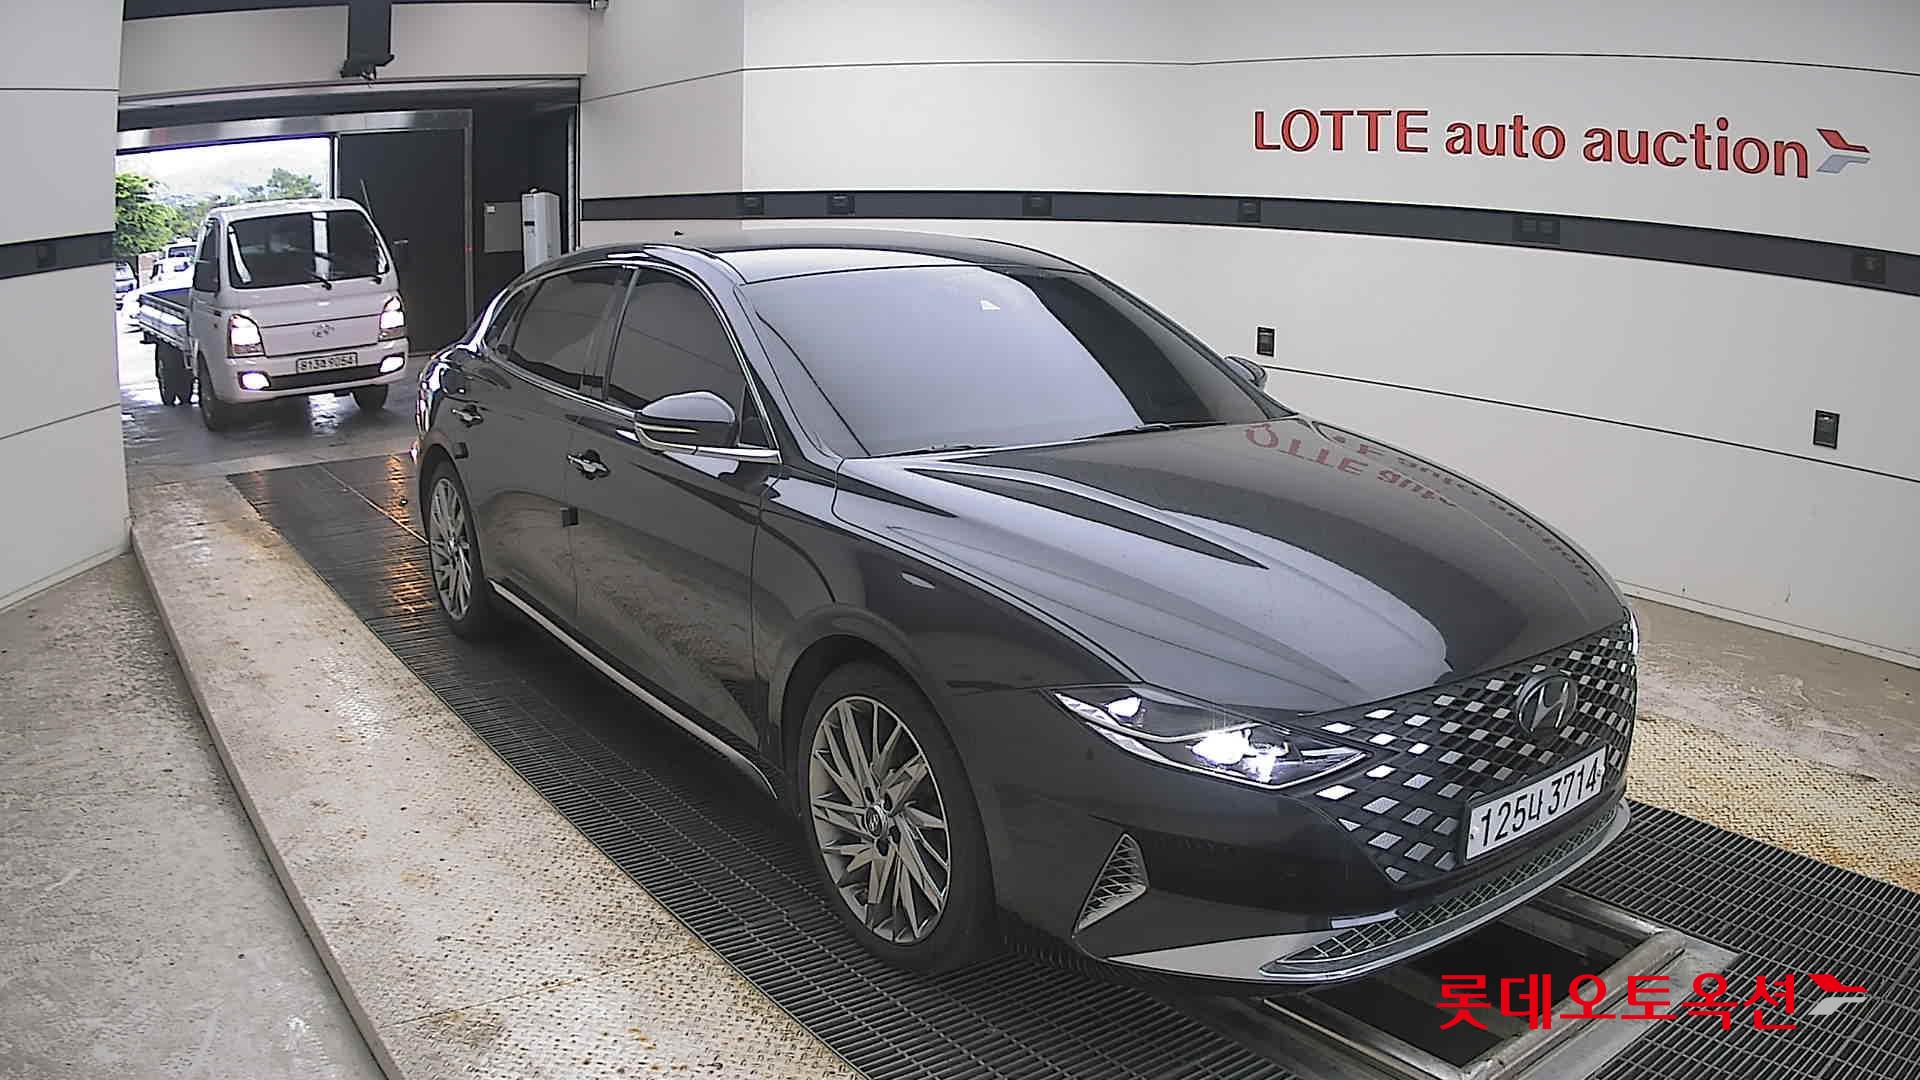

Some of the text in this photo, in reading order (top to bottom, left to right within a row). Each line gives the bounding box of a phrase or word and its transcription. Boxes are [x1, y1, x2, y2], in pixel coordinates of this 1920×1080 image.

[1253, 109, 1809, 178] LOTTE auto auction
[1481, 757, 1599, 847] 125나 3714
